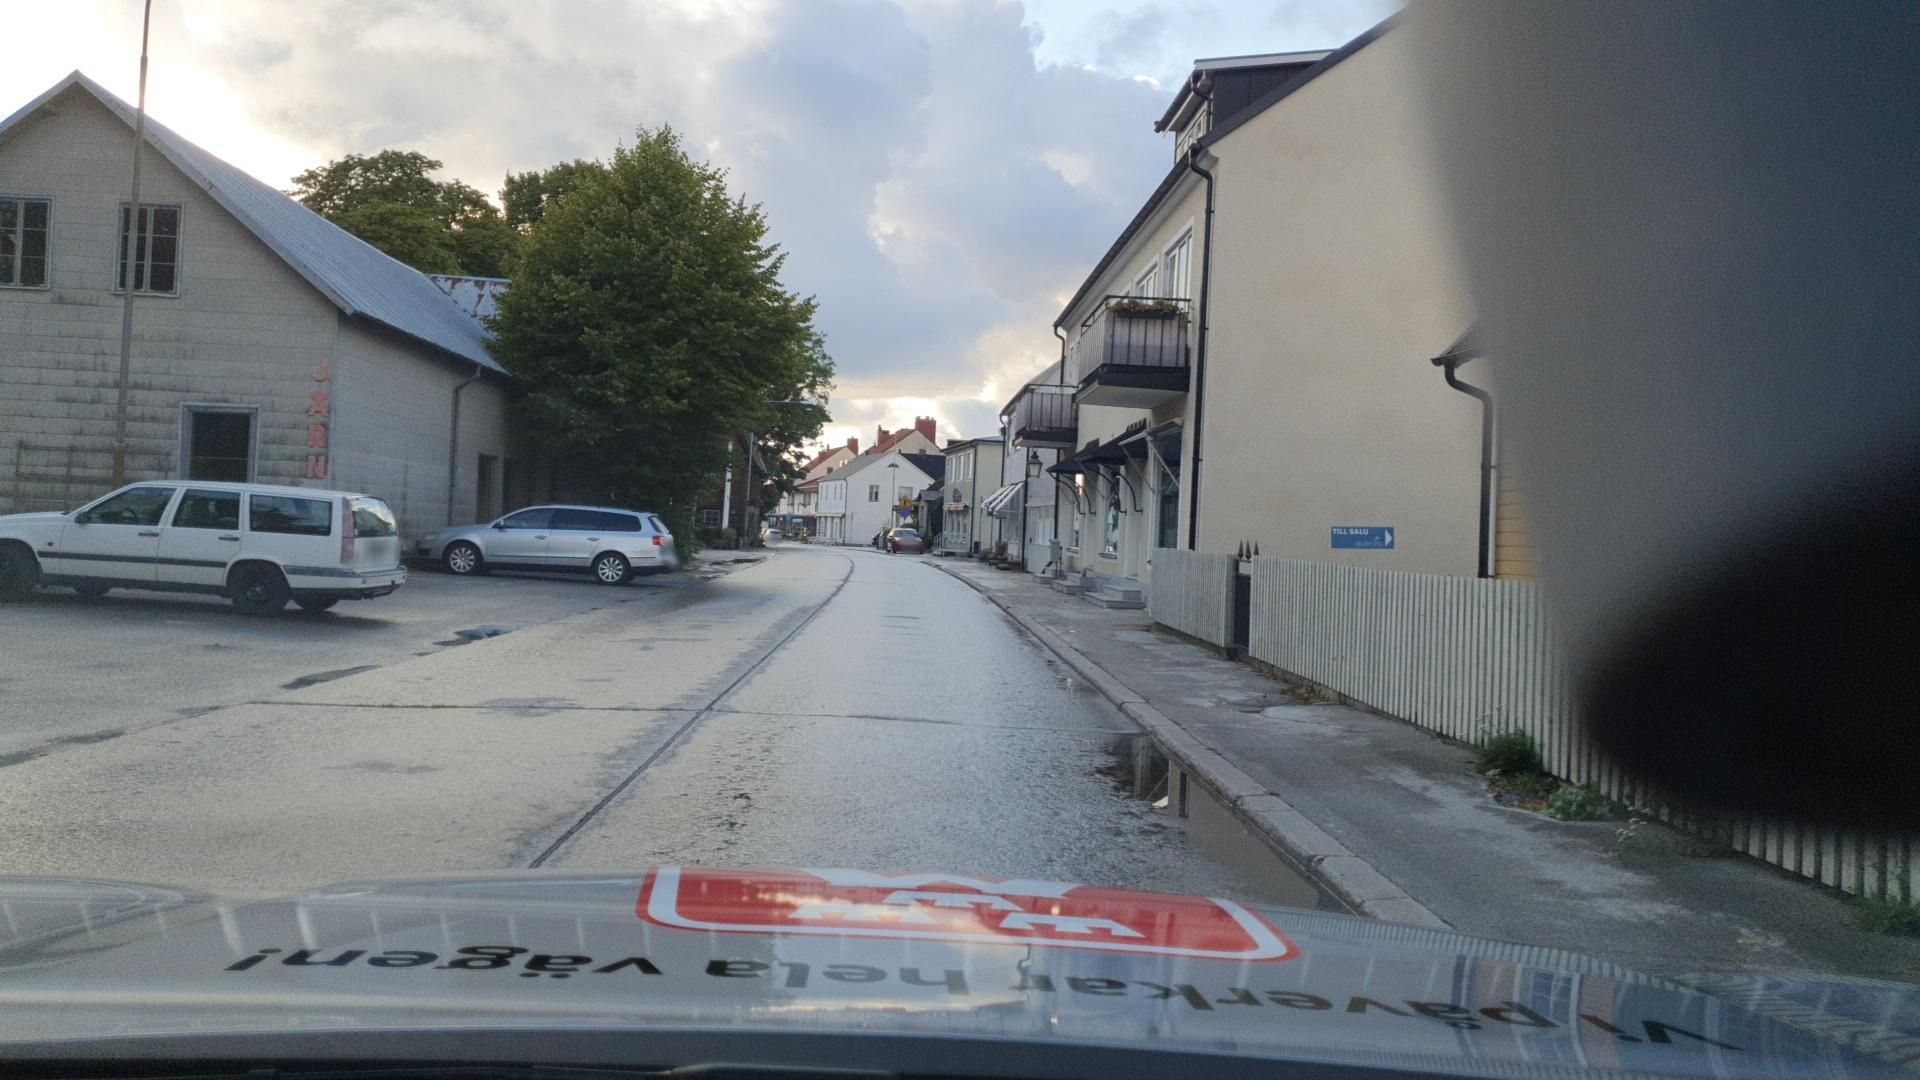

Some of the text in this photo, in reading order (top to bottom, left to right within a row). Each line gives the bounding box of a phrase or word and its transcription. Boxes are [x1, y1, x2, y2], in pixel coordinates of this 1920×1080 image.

[224, 945, 1745, 1052] Vi påverkar hela vägen!
